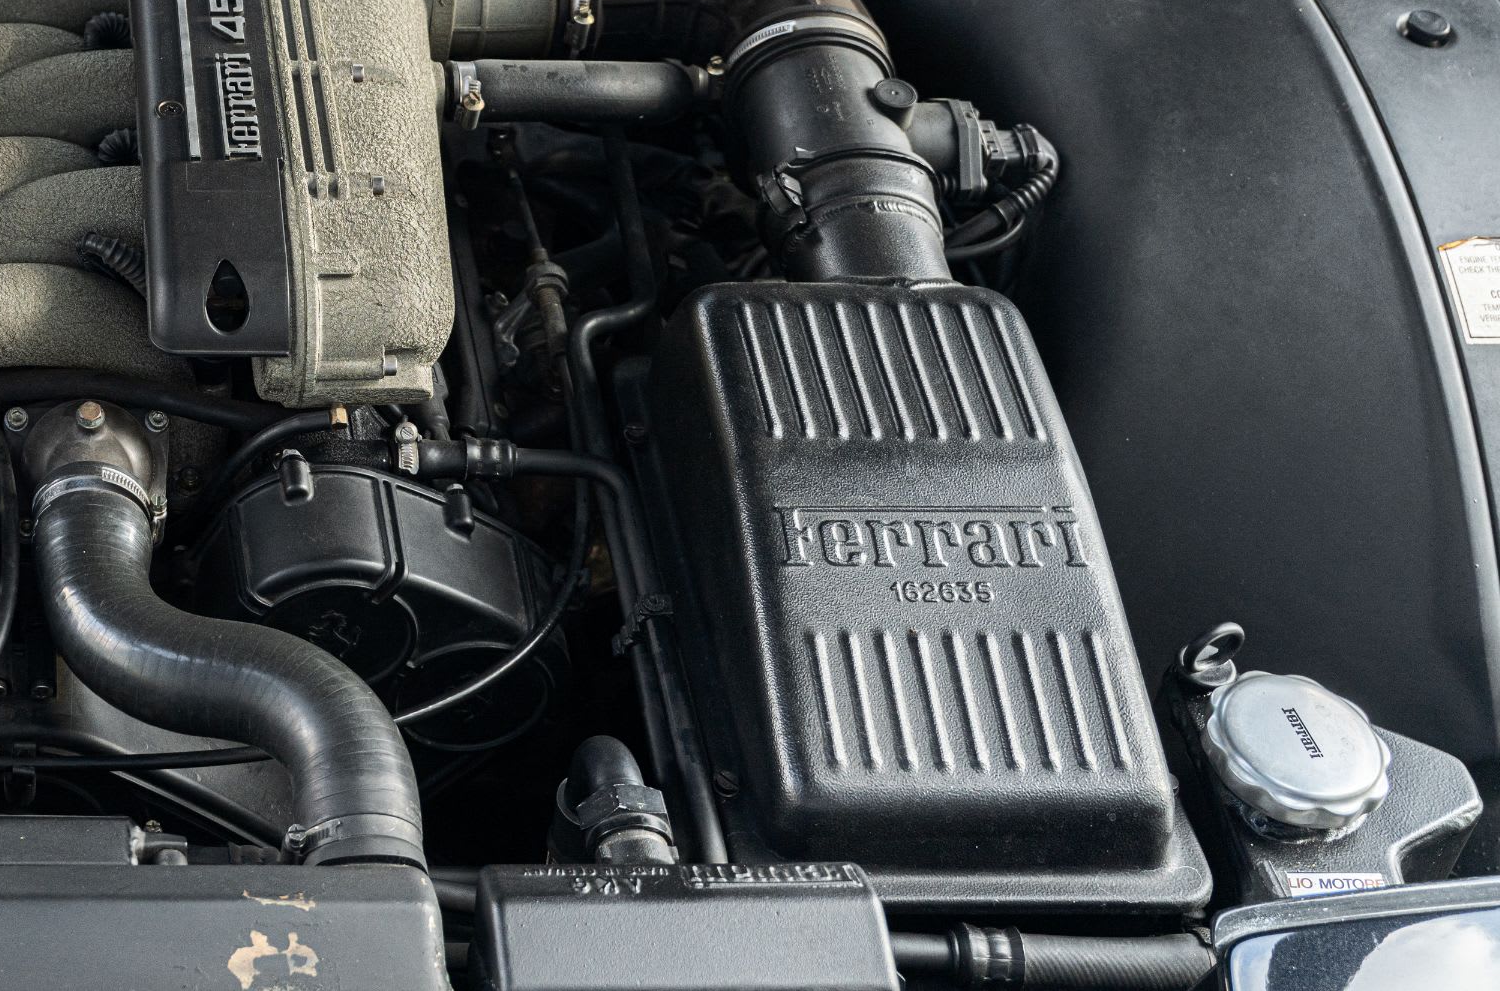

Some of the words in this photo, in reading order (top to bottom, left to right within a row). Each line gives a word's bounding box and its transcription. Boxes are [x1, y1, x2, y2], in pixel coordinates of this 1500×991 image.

[215, 52, 262, 161] Ferrari
[773, 504, 1089, 568] Ferrari
[889, 581, 994, 603] 162635
[1281, 707, 1324, 759] Ferrari
